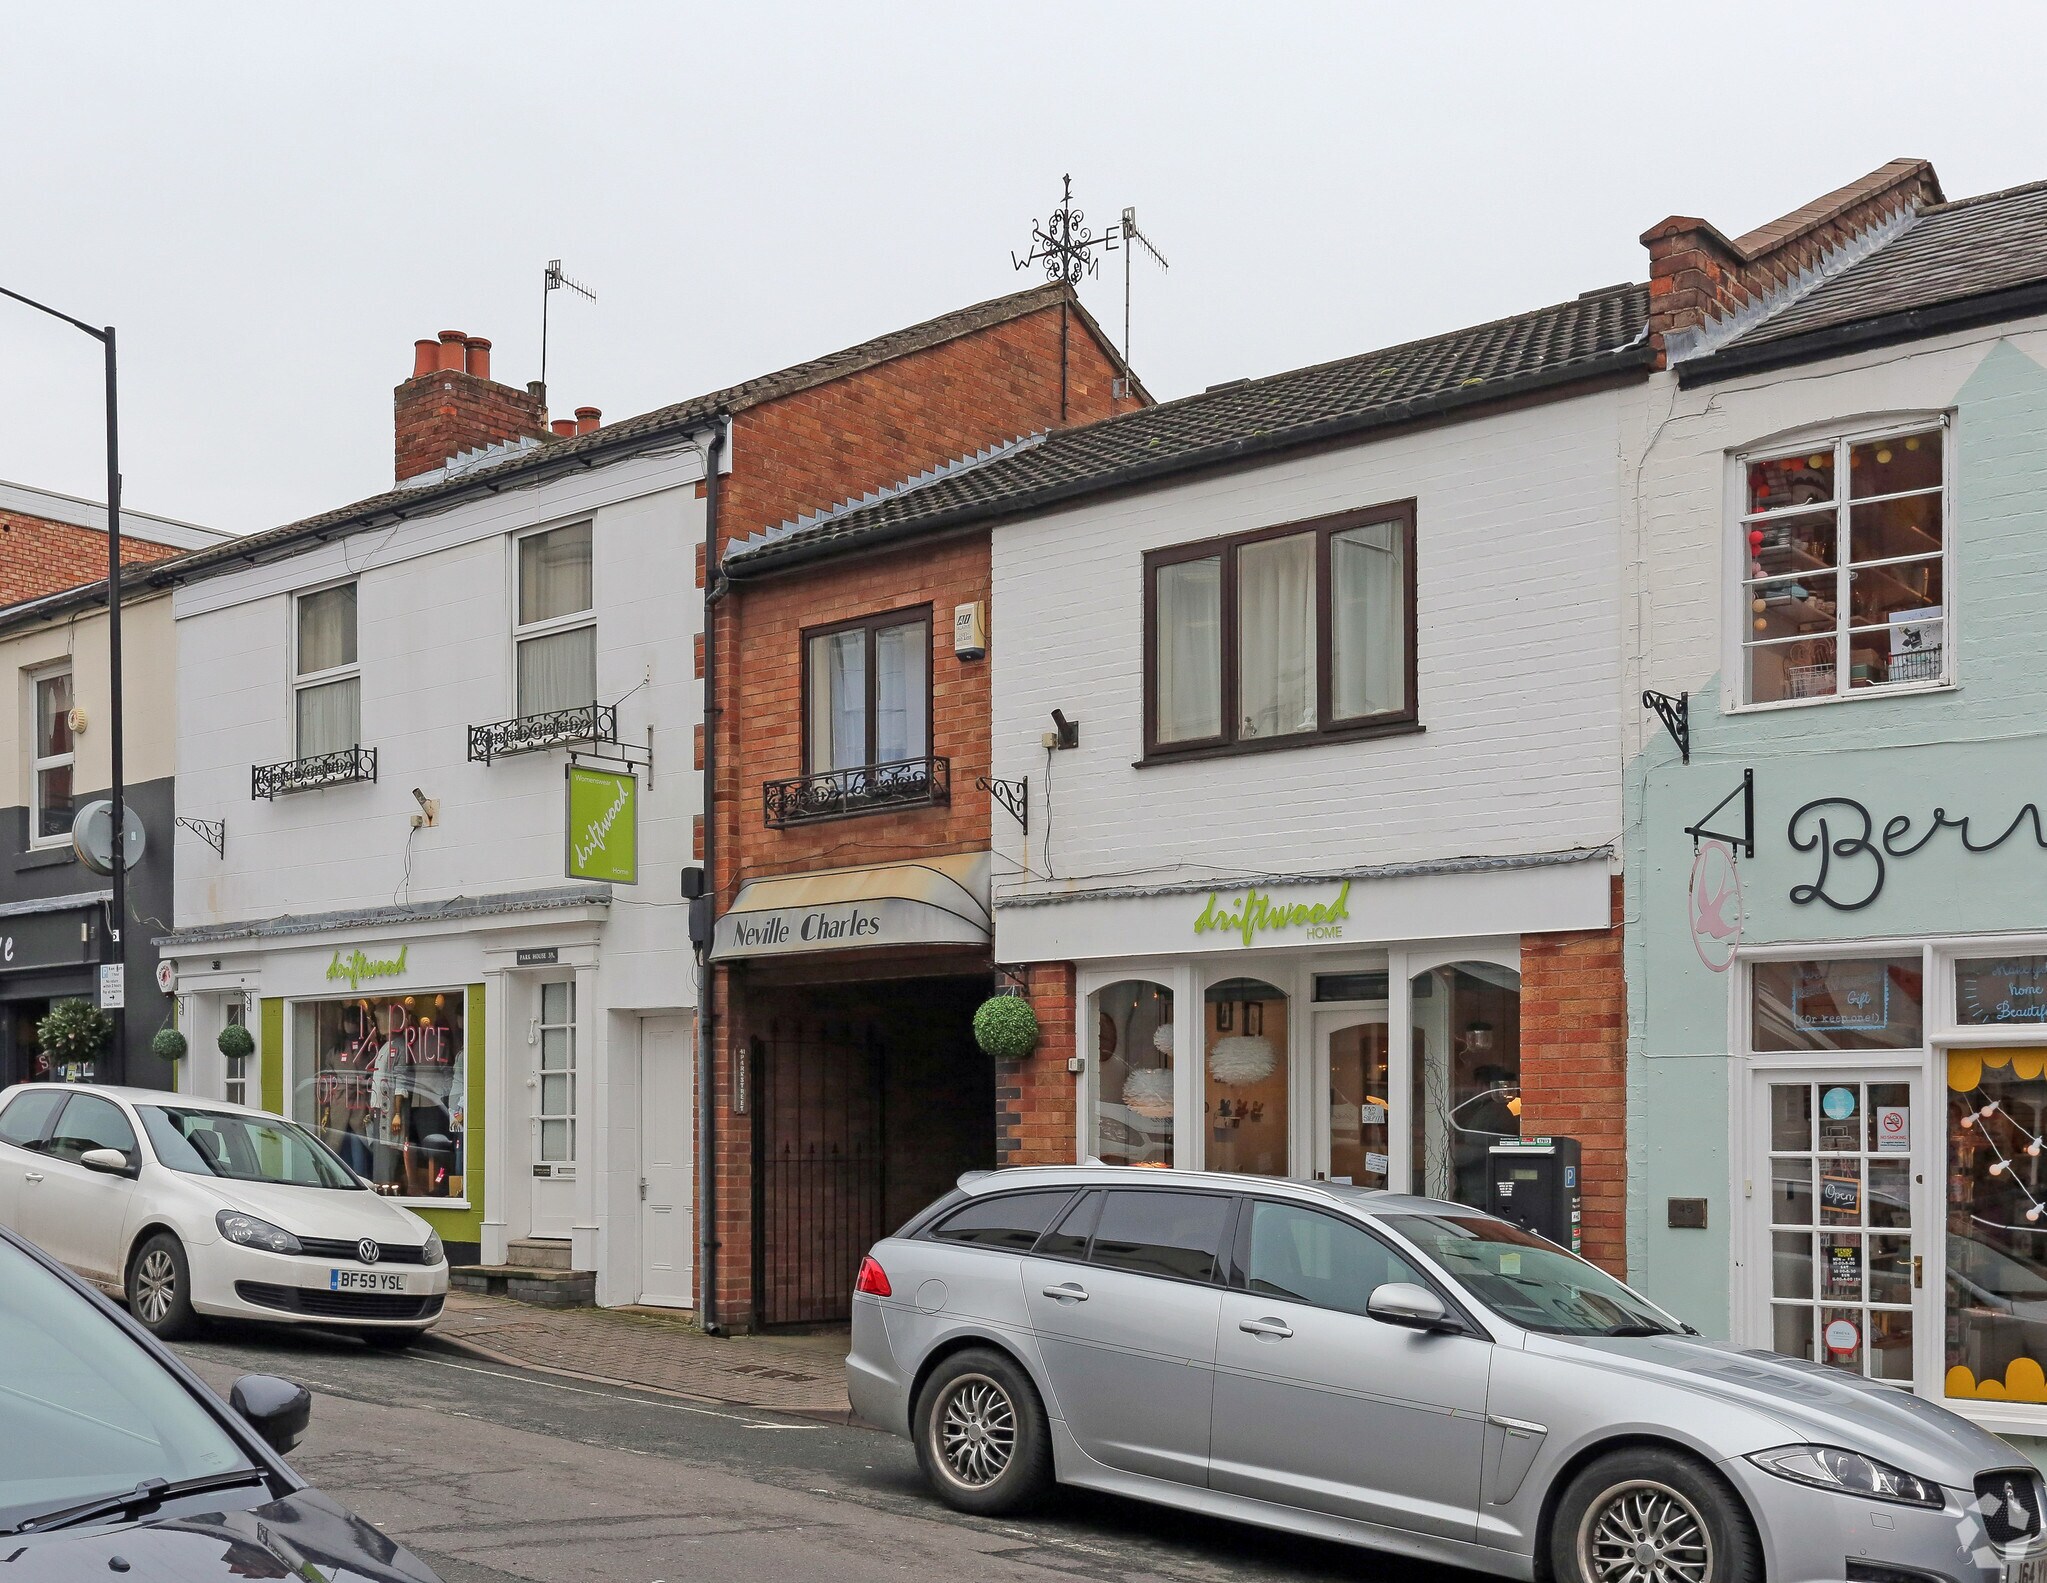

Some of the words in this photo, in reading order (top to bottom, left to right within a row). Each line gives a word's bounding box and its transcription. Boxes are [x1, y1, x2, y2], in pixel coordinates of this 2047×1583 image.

[575, 774, 611, 786] Womenswear
[575, 779, 629, 869] driftwood
[612, 867, 629, 876] Home
[1194, 879, 1351, 947] driftwood
[733, 917, 790, 947] Neville
[800, 909, 881, 942] Charles
[1306, 926, 1343, 940] HOME
[532, 952, 547, 960] HOUSE
[326, 944, 409, 990] driftwood
[2008, 982, 2043, 996] home
[1847, 990, 1871, 1010] Gift
[1821, 1014, 1847, 1025] keep
[388, 1003, 450, 1073] PRICE
[1825, 1184, 1855, 1204] Open
[341, 1272, 377, 1288] BF59
[380, 1275, 404, 1290] YSL
